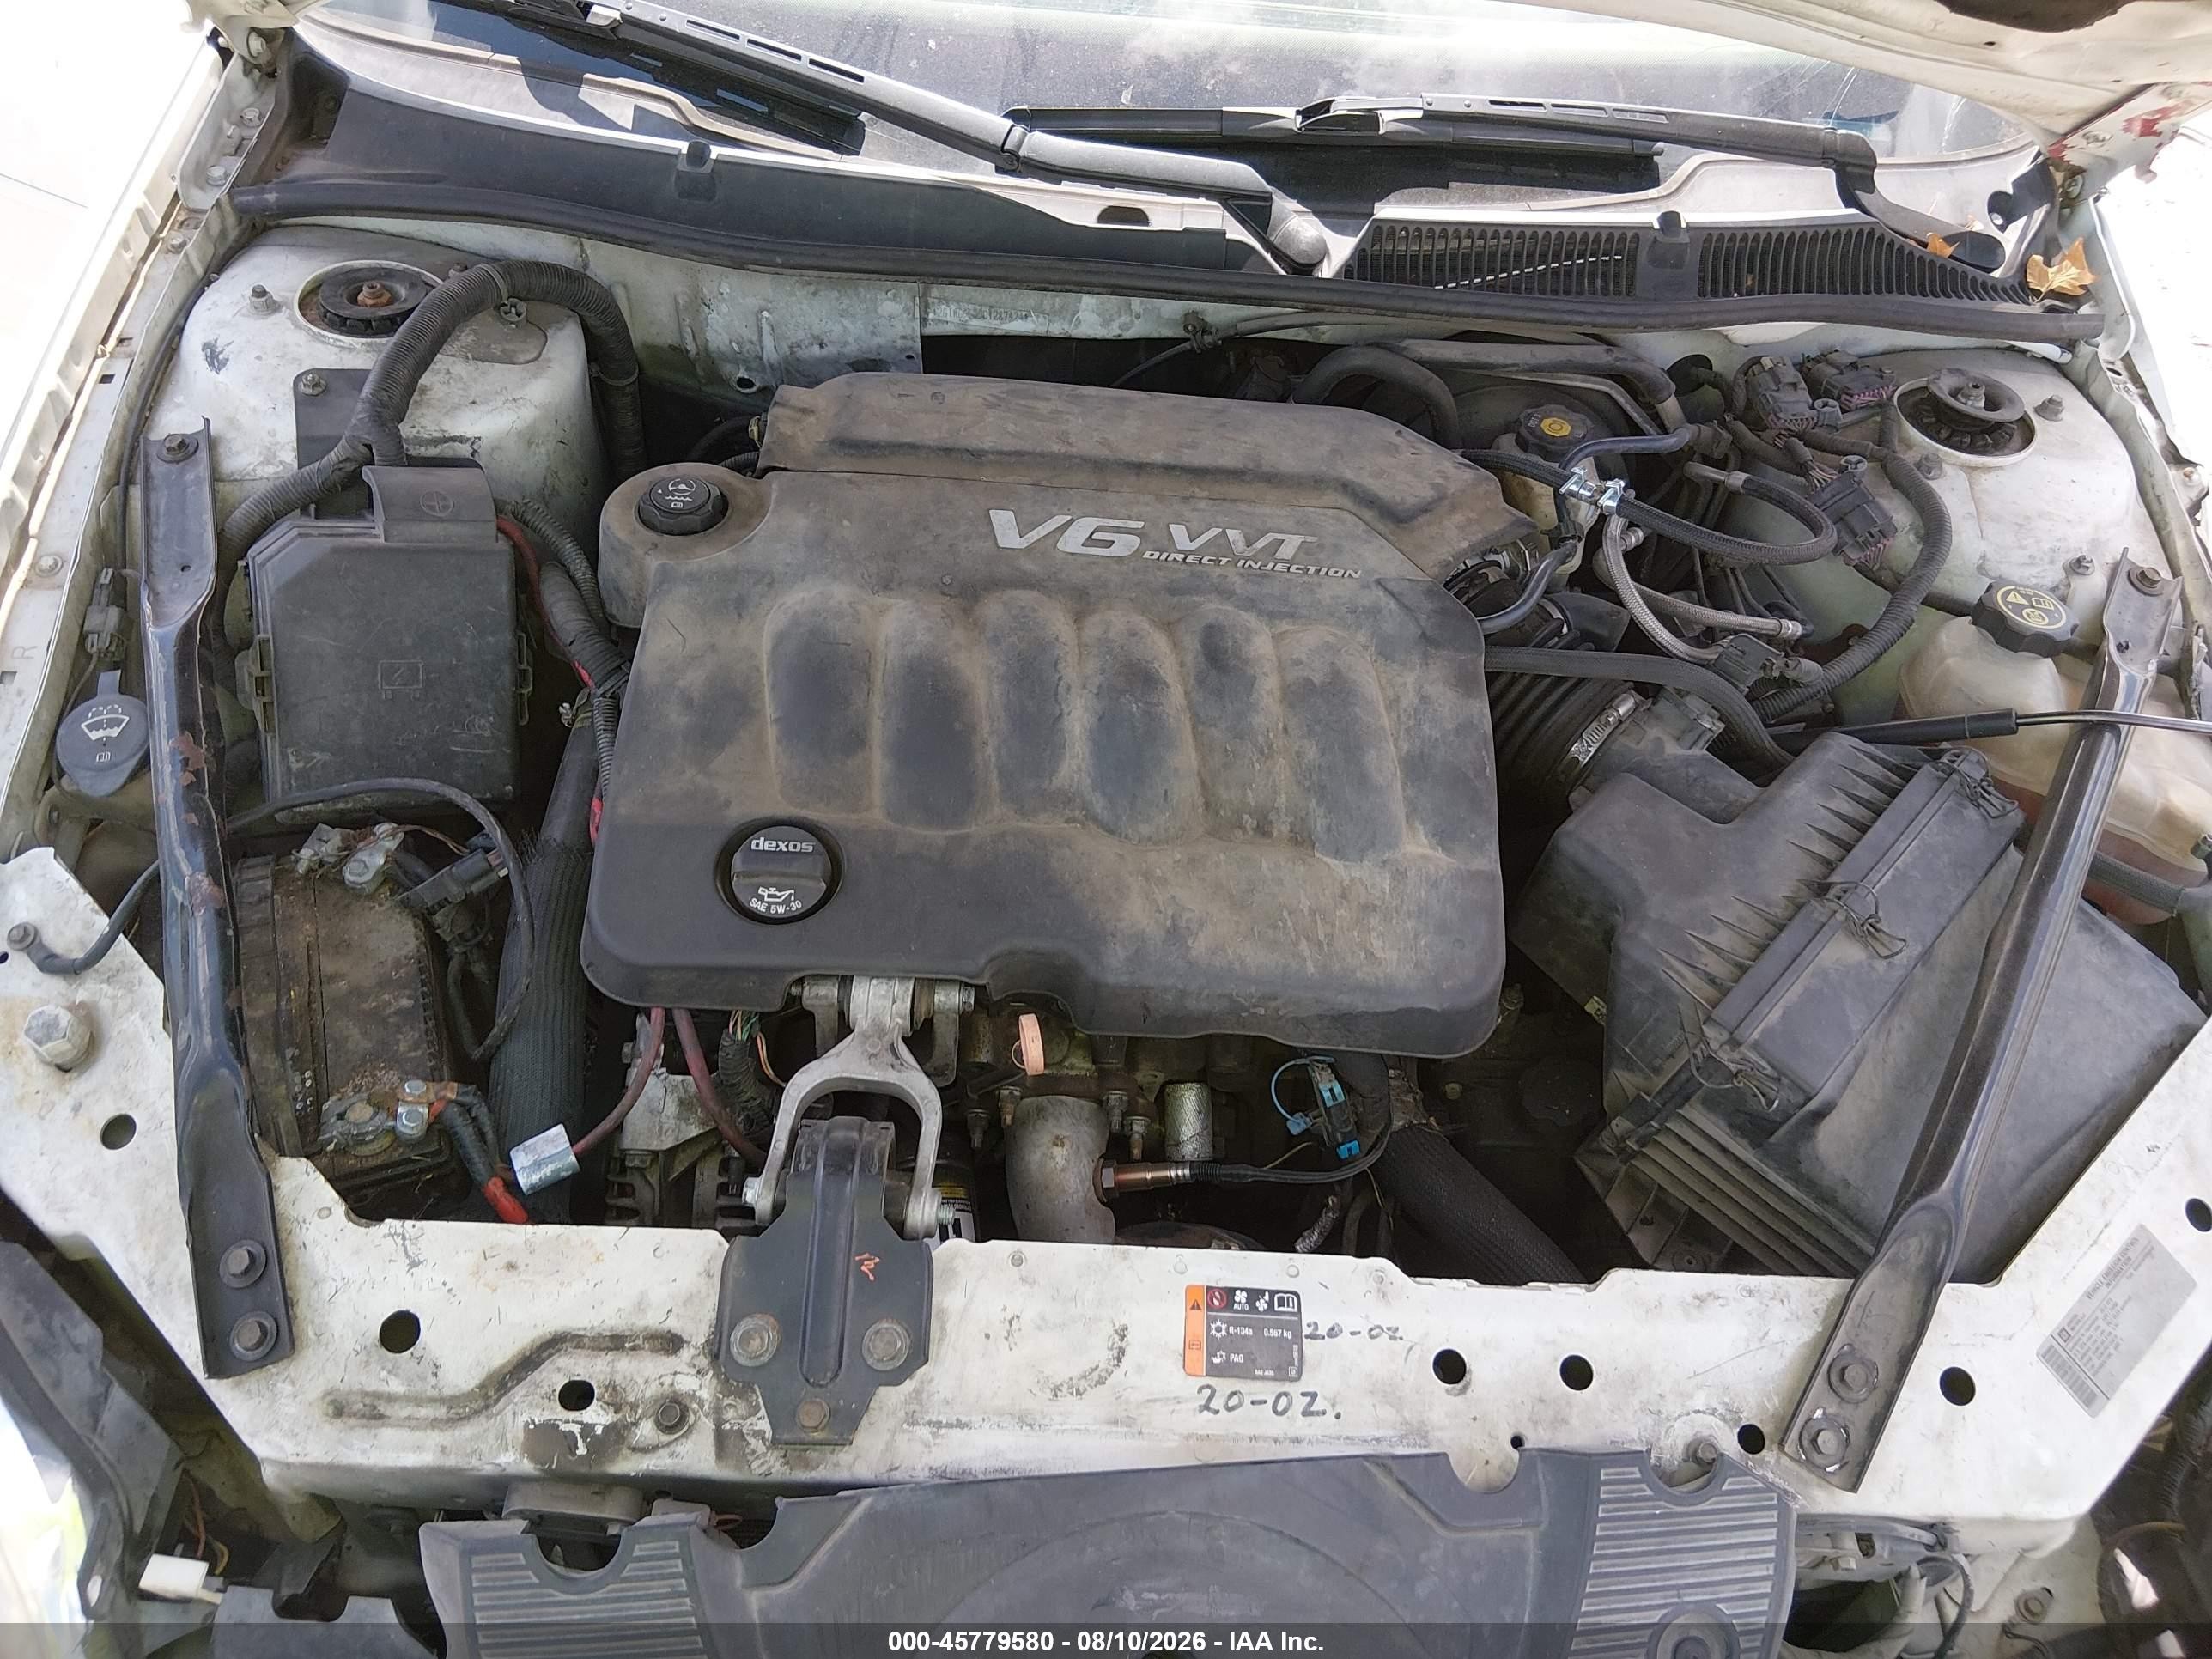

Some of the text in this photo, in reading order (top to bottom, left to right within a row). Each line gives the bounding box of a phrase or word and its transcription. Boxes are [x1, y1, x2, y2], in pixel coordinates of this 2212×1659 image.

[988, 509, 1318, 561] V6 VVT
[1141, 550, 1362, 580] DIRECT INJECTION
[750, 836, 817, 853] dexos
[749, 897, 803, 915] SAE 5W-30
[1232, 1303, 1249, 1311] AUTO
[1228, 1326, 1254, 1337] R-134a
[1283, 1328, 1293, 1340] kg
